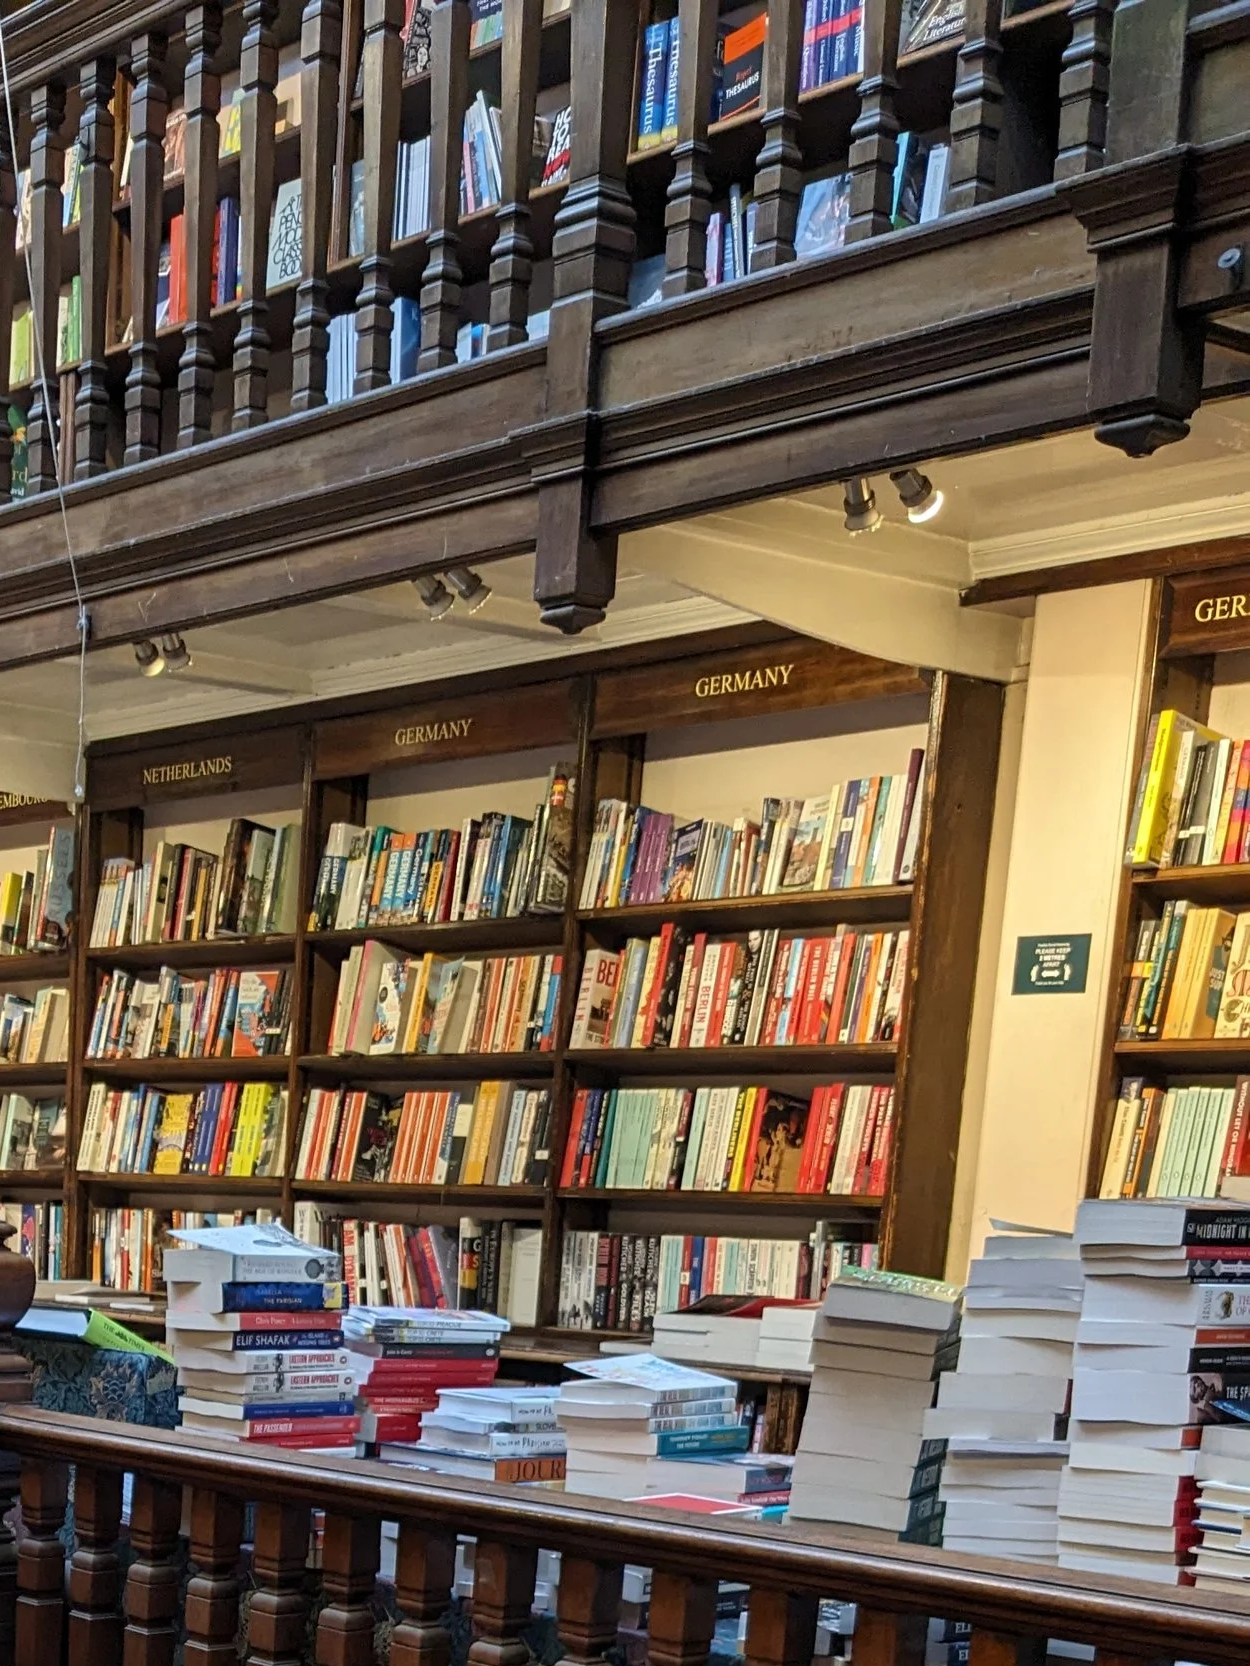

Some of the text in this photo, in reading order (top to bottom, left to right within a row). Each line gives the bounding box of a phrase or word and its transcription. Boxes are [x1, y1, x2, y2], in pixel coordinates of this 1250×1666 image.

[642, 44, 663, 135] Thesaurus
[725, 72, 759, 99] THESAURUS
[1195, 595, 1250, 622] GER
[695, 664, 794, 698] GERMANY
[395, 718, 472, 746] GERMANY
[143, 756, 232, 785] NETHERLANDS
[696, 985, 711, 1023] BERLIN
[1196, 1224, 1237, 1239] MIDNIGHT
[236, 1335, 290, 1346] ELIF SHAFAK
[1226, 1386, 1238, 1399] THE
